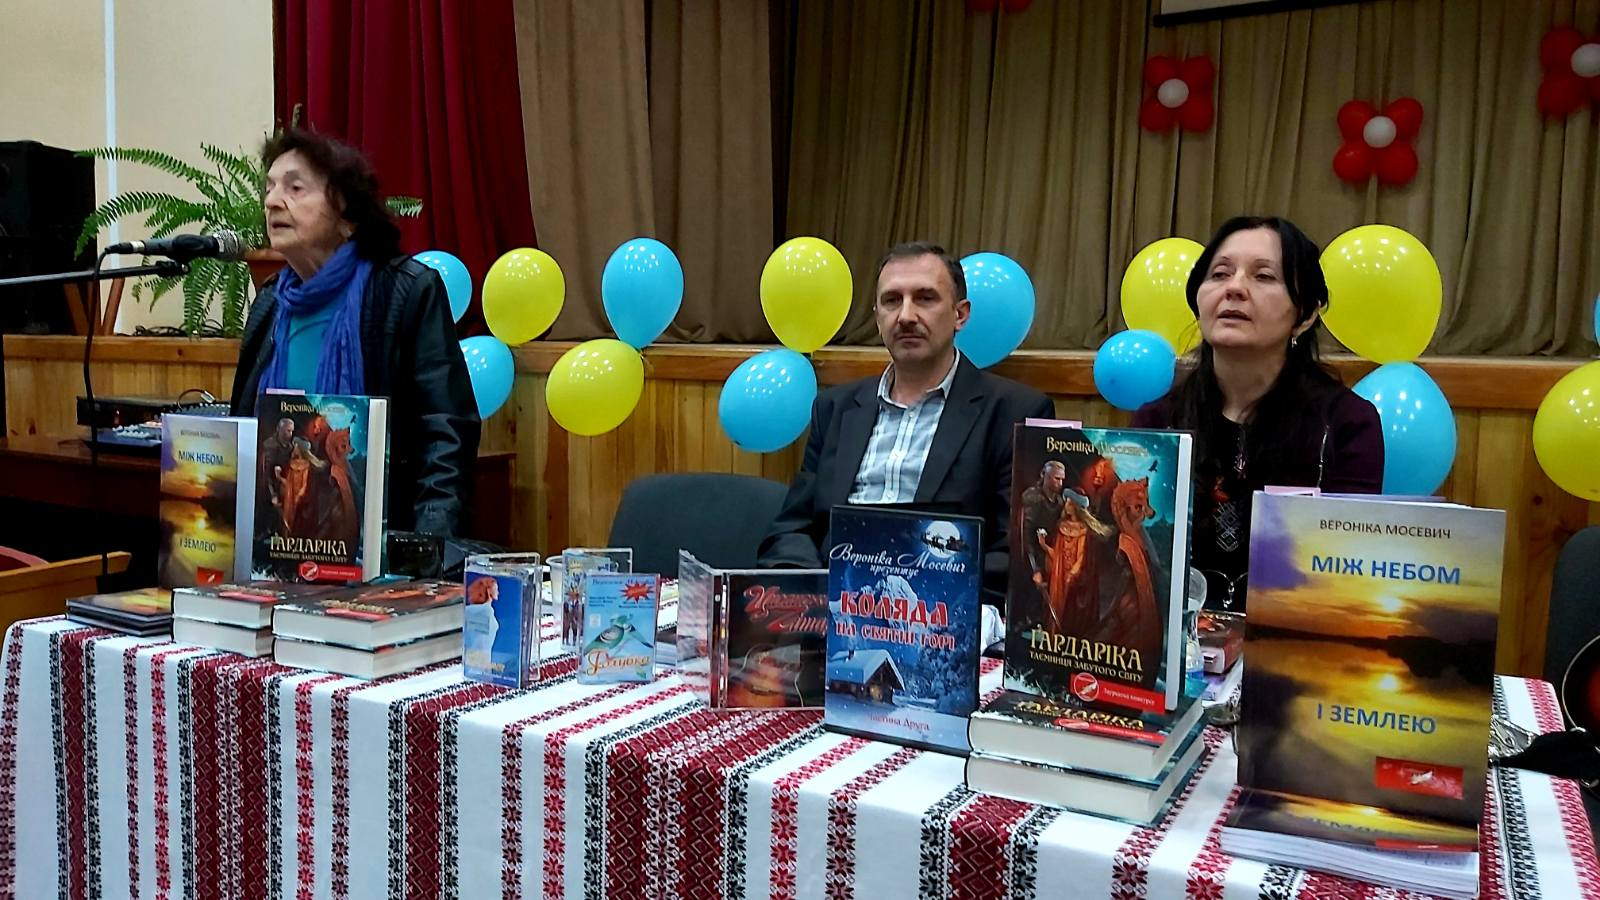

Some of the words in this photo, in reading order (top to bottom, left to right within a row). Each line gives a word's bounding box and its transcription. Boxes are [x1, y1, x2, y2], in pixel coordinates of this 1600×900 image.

[178, 450, 195, 461] МІЖ
[196, 452, 224, 465] НЕБОМ
[1046, 437, 1094, 455] Вероніка
[1320, 519, 1382, 535] ВЕРОНІКА
[1385, 524, 1451, 539] МОСЕВИЧ
[184, 538, 217, 553] ЗЕМЛЕЮ
[830, 543, 892, 567] Вероніка
[897, 551, 966, 573] Мосевич
[1311, 555, 1364, 576] МІЖ
[1371, 560, 1461, 585] НЕБОМ
[840, 590, 949, 628] КОЛЯДА
[835, 621, 857, 637] НА
[920, 632, 956, 650] ГОРІ
[1073, 658, 1117, 677] ЗАБУТОГО
[1117, 669, 1144, 682] СВІТУ
[1317, 703, 1323, 719] І
[1330, 704, 1437, 734] ЗЕМЛЕЮ
